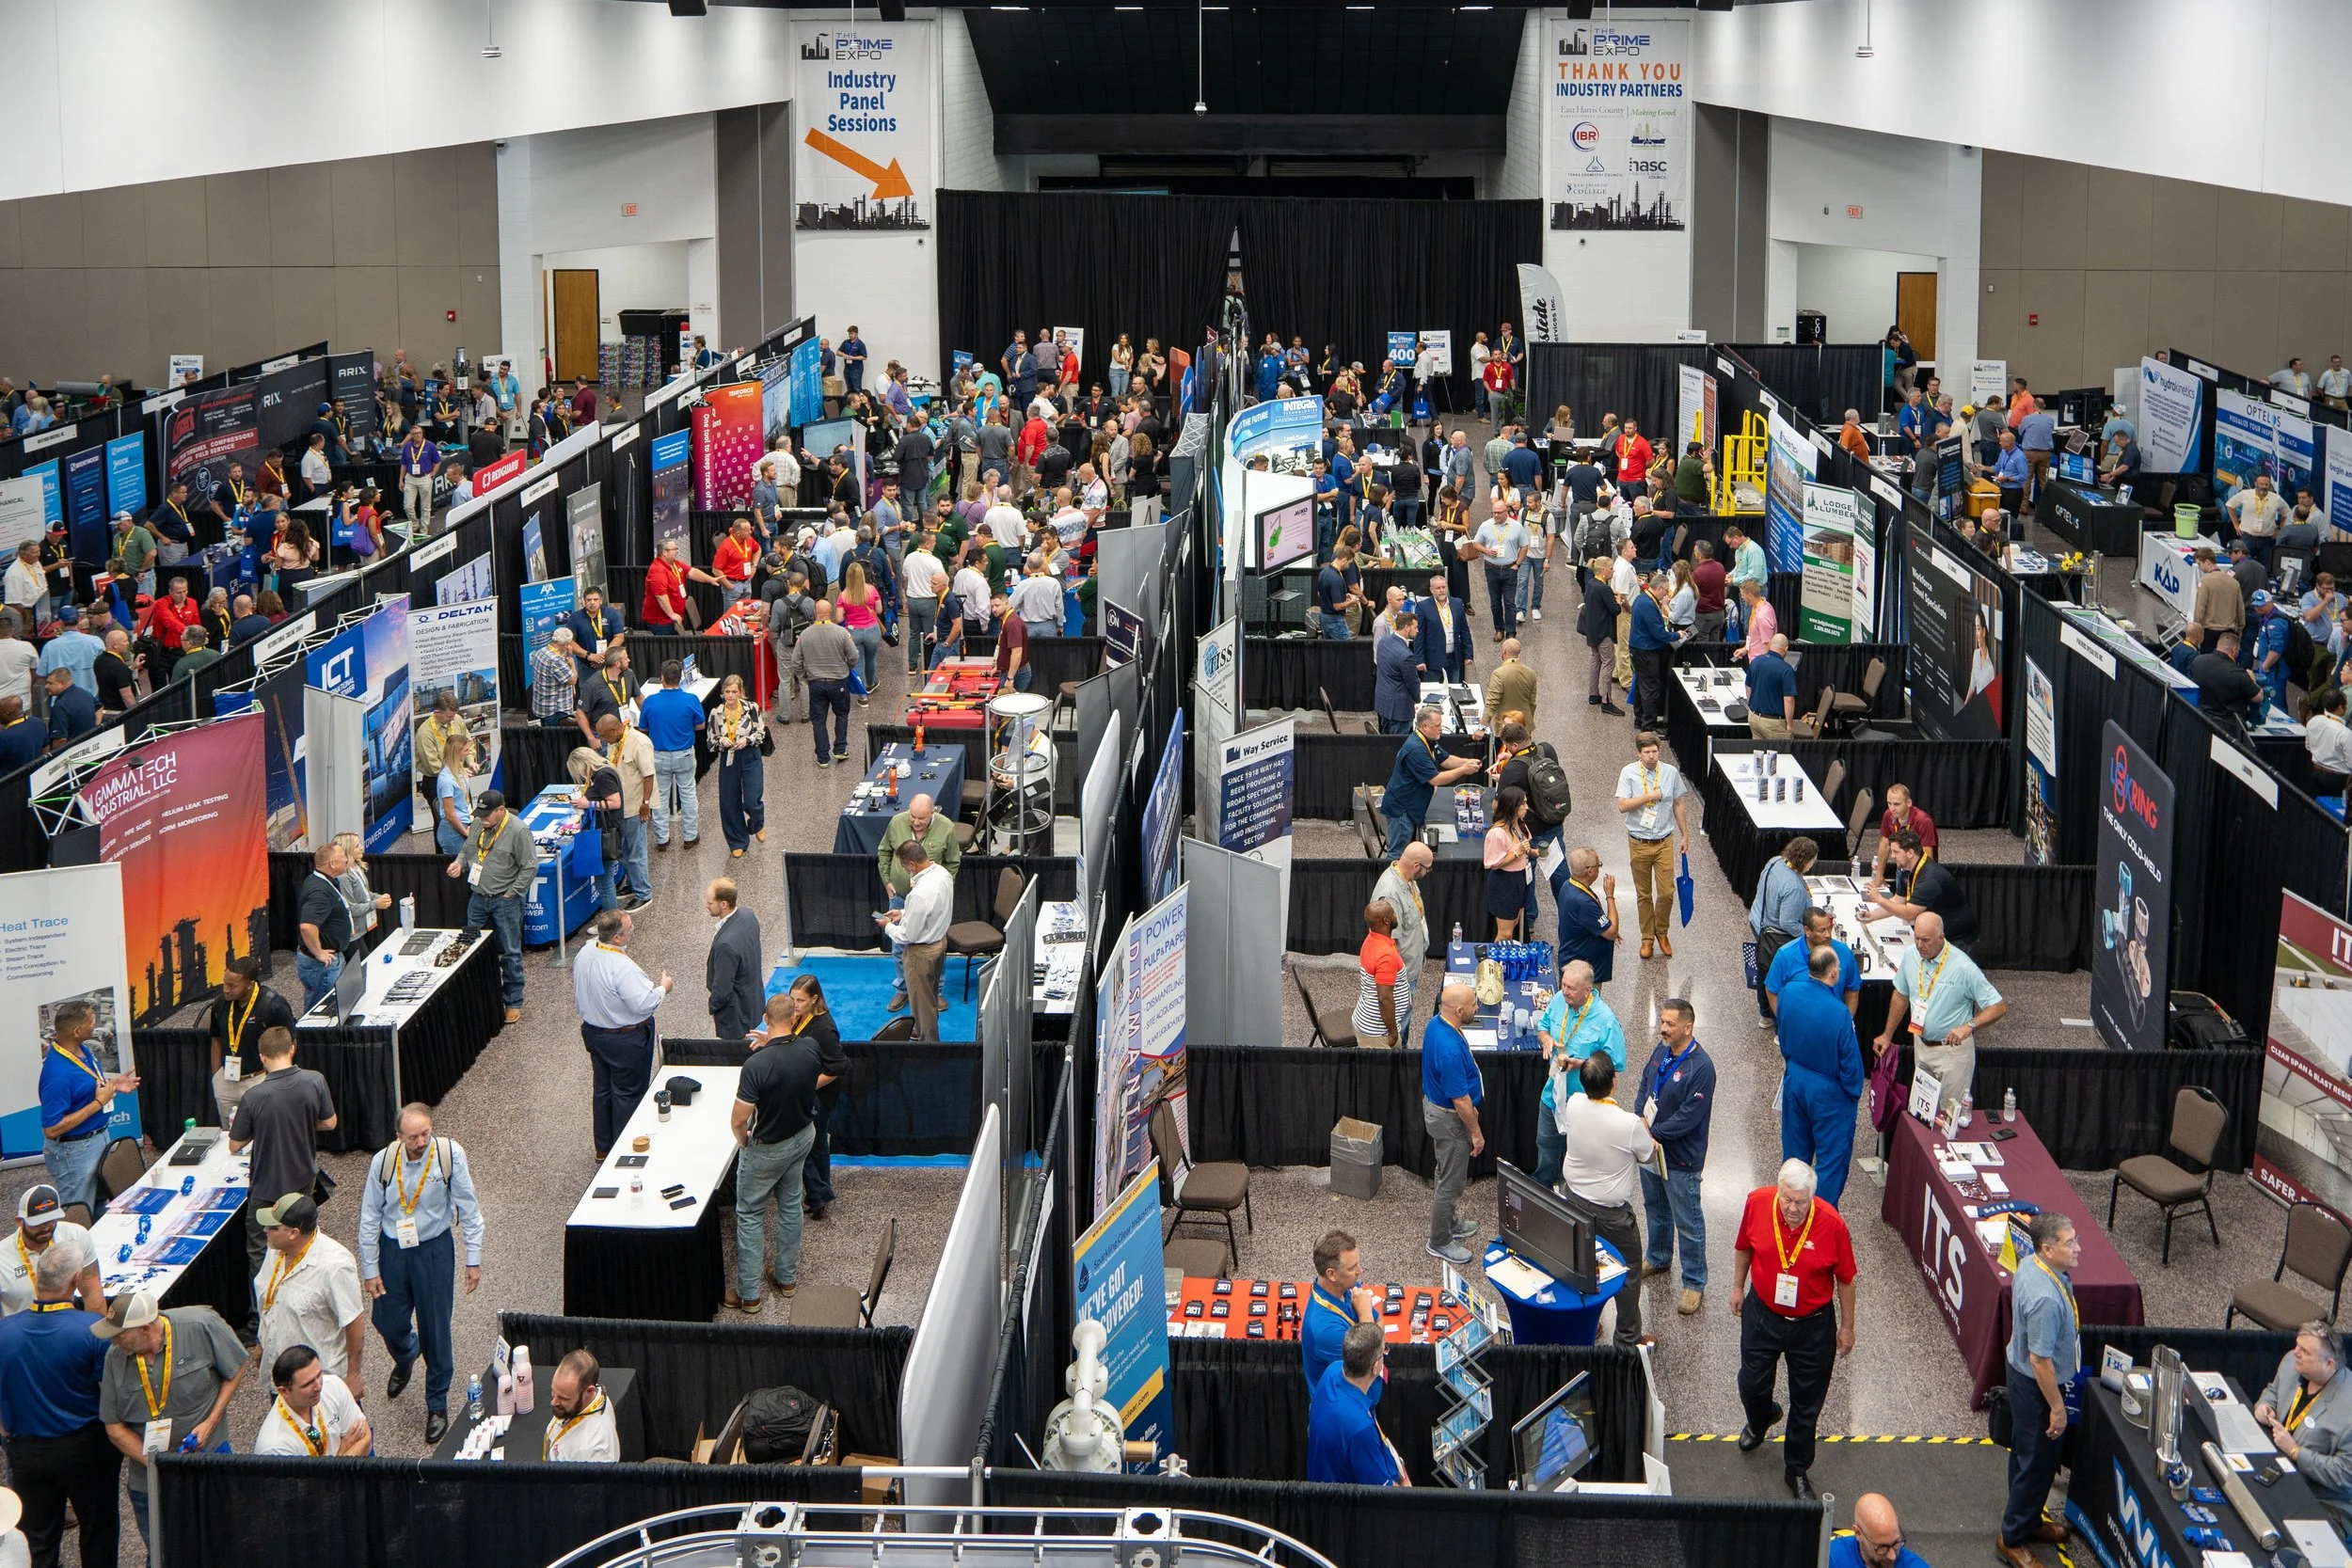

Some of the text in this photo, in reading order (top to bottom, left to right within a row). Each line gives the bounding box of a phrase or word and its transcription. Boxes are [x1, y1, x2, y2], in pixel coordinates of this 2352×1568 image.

[835, 39, 893, 50] PRIME
[1594, 35, 1650, 46] PRIME
[835, 50, 882, 60] EXPO
[1594, 47, 1641, 56] EXPO
[828, 70, 897, 92] Industry
[1558, 62, 1681, 81] THANK YOU
[1556, 83, 1683, 98] INDUSTRY PARTNERS
[840, 91, 884, 110] Panel
[1598, 106, 1625, 116] County
[1630, 108, 1657, 118] Making
[828, 113, 897, 133] Sessions
[1577, 132, 1597, 141] IBR
[1389, 349, 1415, 361] 400
[339, 366, 367, 378] ARIX
[2160, 375, 2196, 399] hydrokinetics
[1283, 399, 1317, 411] INTEGRA
[1251, 410, 1268, 423] FUTURE
[2247, 404, 2280, 427] OPTELOS
[211, 432, 254, 448] COMPRESSORS
[2286, 436, 2297, 448] DATA
[196, 443, 235, 459] FIELD SERVICE
[491, 459, 519, 482] REDGUARD
[706, 489, 713, 498] of
[1820, 506, 1855, 518] LUMBER
[1823, 499, 1852, 512] LODGE
[2056, 504, 2079, 530] OPTELOS
[1820, 561, 1840, 570] PRODUCTS
[1912, 566, 1932, 593] Workforce
[1913, 582, 1947, 620] Travel Specialists
[438, 604, 493, 620] DELTAK
[416, 626, 440, 636] DESIGN
[448, 617, 489, 630] FABRICATION
[322, 645, 354, 691] ICT
[1243, 734, 1289, 758] Way Service
[1227, 758, 1285, 786] SINCE 1918 WAY HAS
[1231, 784, 1246, 796] BEEN
[1246, 774, 1276, 792] PROVIDING
[95, 769, 177, 821] INDUSTRIAL, LLC
[1227, 781, 1285, 809] BROAD SPECTRUM OF
[162, 794, 229, 818] HELIUM LEAK TESTING
[1229, 792, 1283, 820] FACILITY SOLUTIONS
[177, 811, 218, 828] MONITORING
[1225, 802, 1285, 833] FOR THE COMMERCIAL
[124, 819, 152, 837] PIPE SCANS
[1232, 816, 1277, 841] AND INDUSTRIAL
[130, 834, 151, 850] SERVICES
[1244, 831, 1266, 847] SECTOR
[2104, 805, 2162, 882] THE ONLY COLD-WELD
[0, 918, 68, 932] Heat Trace
[1146, 904, 1184, 945] POWER
[28, 932, 66, 941] Independent
[1144, 948, 1160, 971] PULP
[1165, 929, 1186, 956] PAPER
[24, 961, 58, 970] Conception
[8, 971, 53, 980] Commissioning
[1147, 975, 1185, 1012] DISMANTLING
[1146, 1012, 1159, 1030] SITE
[2271, 1045, 2290, 1063] CLEAR
[2290, 1057, 2309, 1073] SPAN
[2313, 1070, 2333, 1089] BLAST
[1917, 1097, 1931, 1112] ITS
[1094, 1200, 1155, 1269] Sparkling Clear Industries
[1922, 1181, 1967, 1311] ITS
[1078, 1260, 1126, 1321] WE'VE GOT
[1102, 1275, 1143, 1334] COVERED!
[2107, 1513, 2128, 1557] WOVEN
